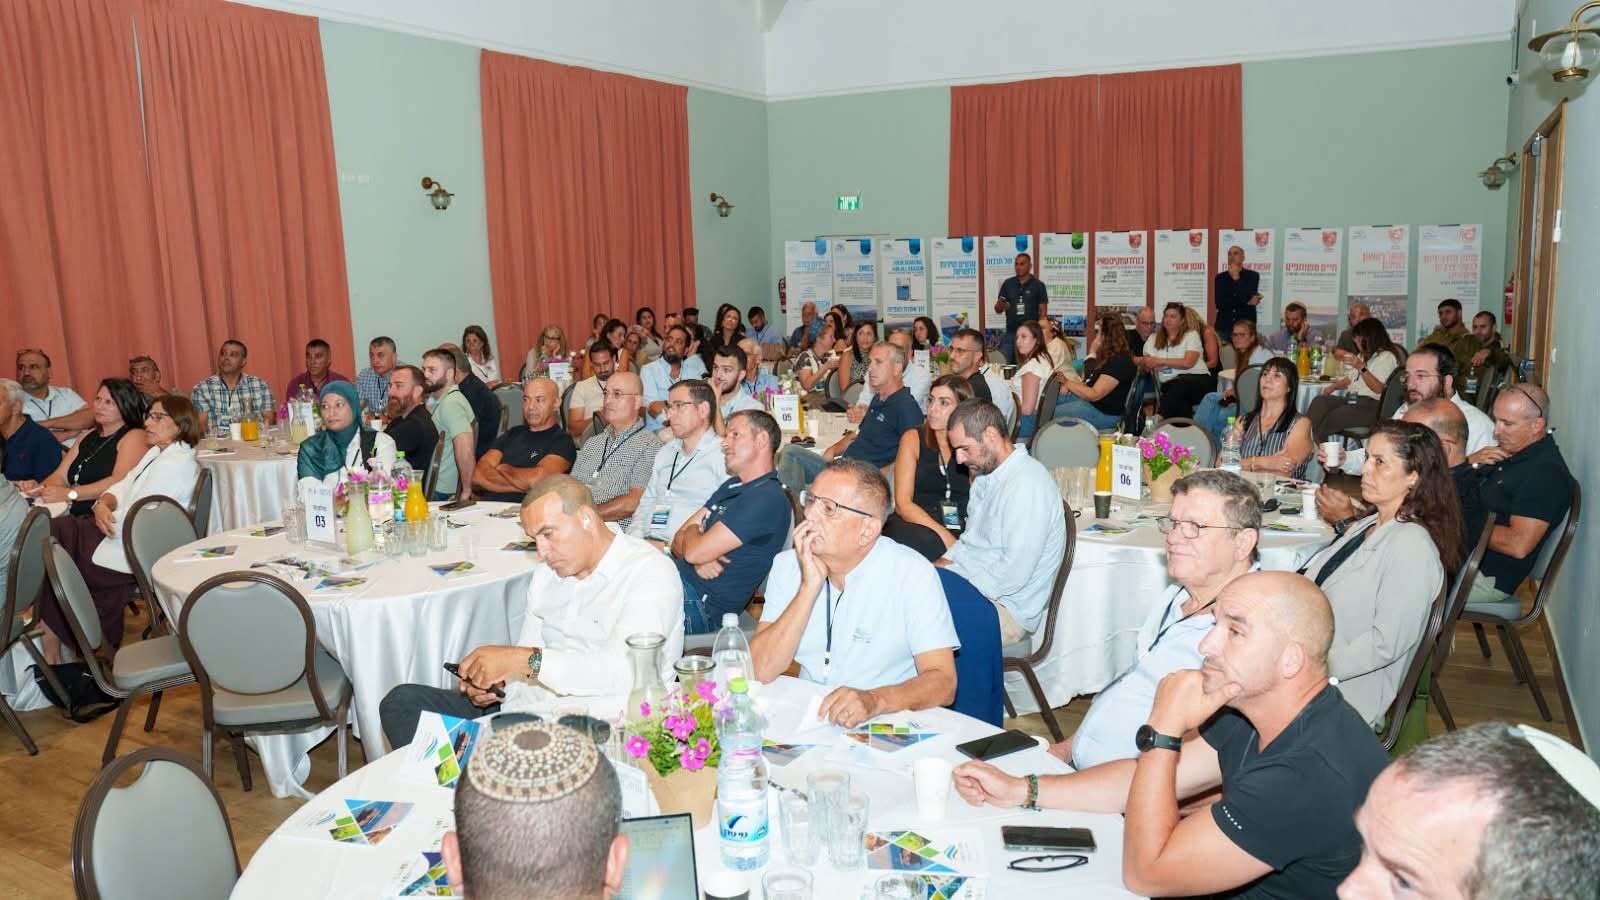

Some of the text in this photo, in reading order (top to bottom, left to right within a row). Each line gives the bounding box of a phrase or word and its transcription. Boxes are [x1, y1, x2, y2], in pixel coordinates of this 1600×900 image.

[839, 196, 858, 209] יציאה
[1120, 473, 1131, 486] 06
[315, 515, 326, 527] 03
